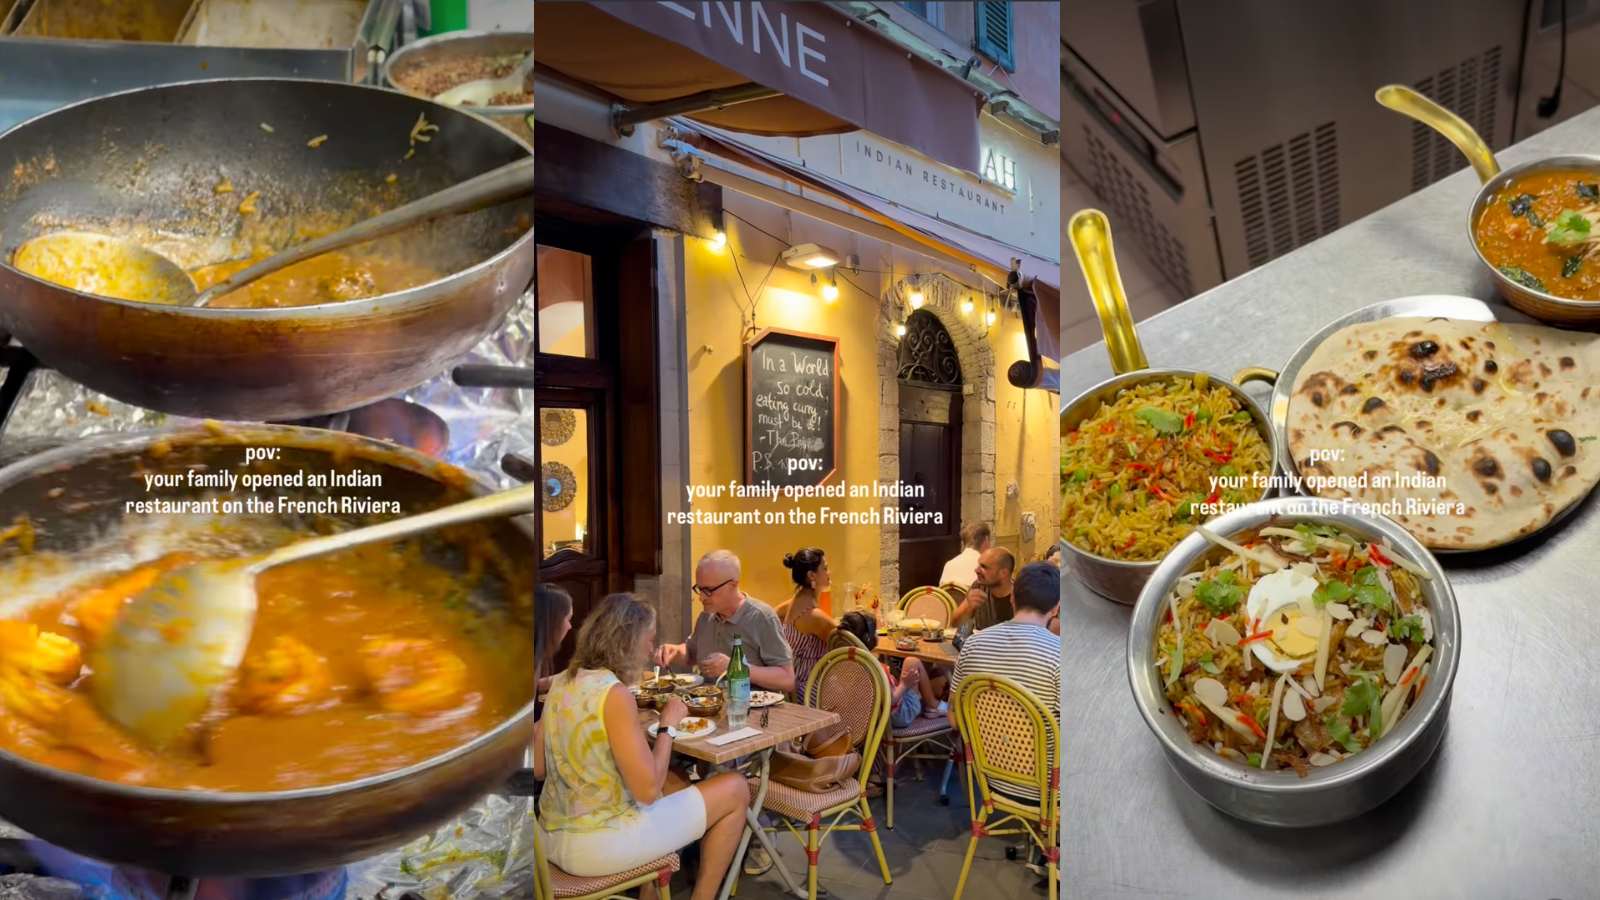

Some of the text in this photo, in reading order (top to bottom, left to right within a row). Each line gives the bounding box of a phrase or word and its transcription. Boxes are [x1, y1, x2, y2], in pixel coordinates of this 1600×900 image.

[657, 1, 829, 87] NNE
[856, 140, 1006, 215] INDIAN RESTAURANT
[779, 358, 787, 372] a
[790, 351, 829, 377] World
[756, 392, 818, 423] eating curry
[758, 413, 783, 429] must
[791, 415, 803, 430] be
